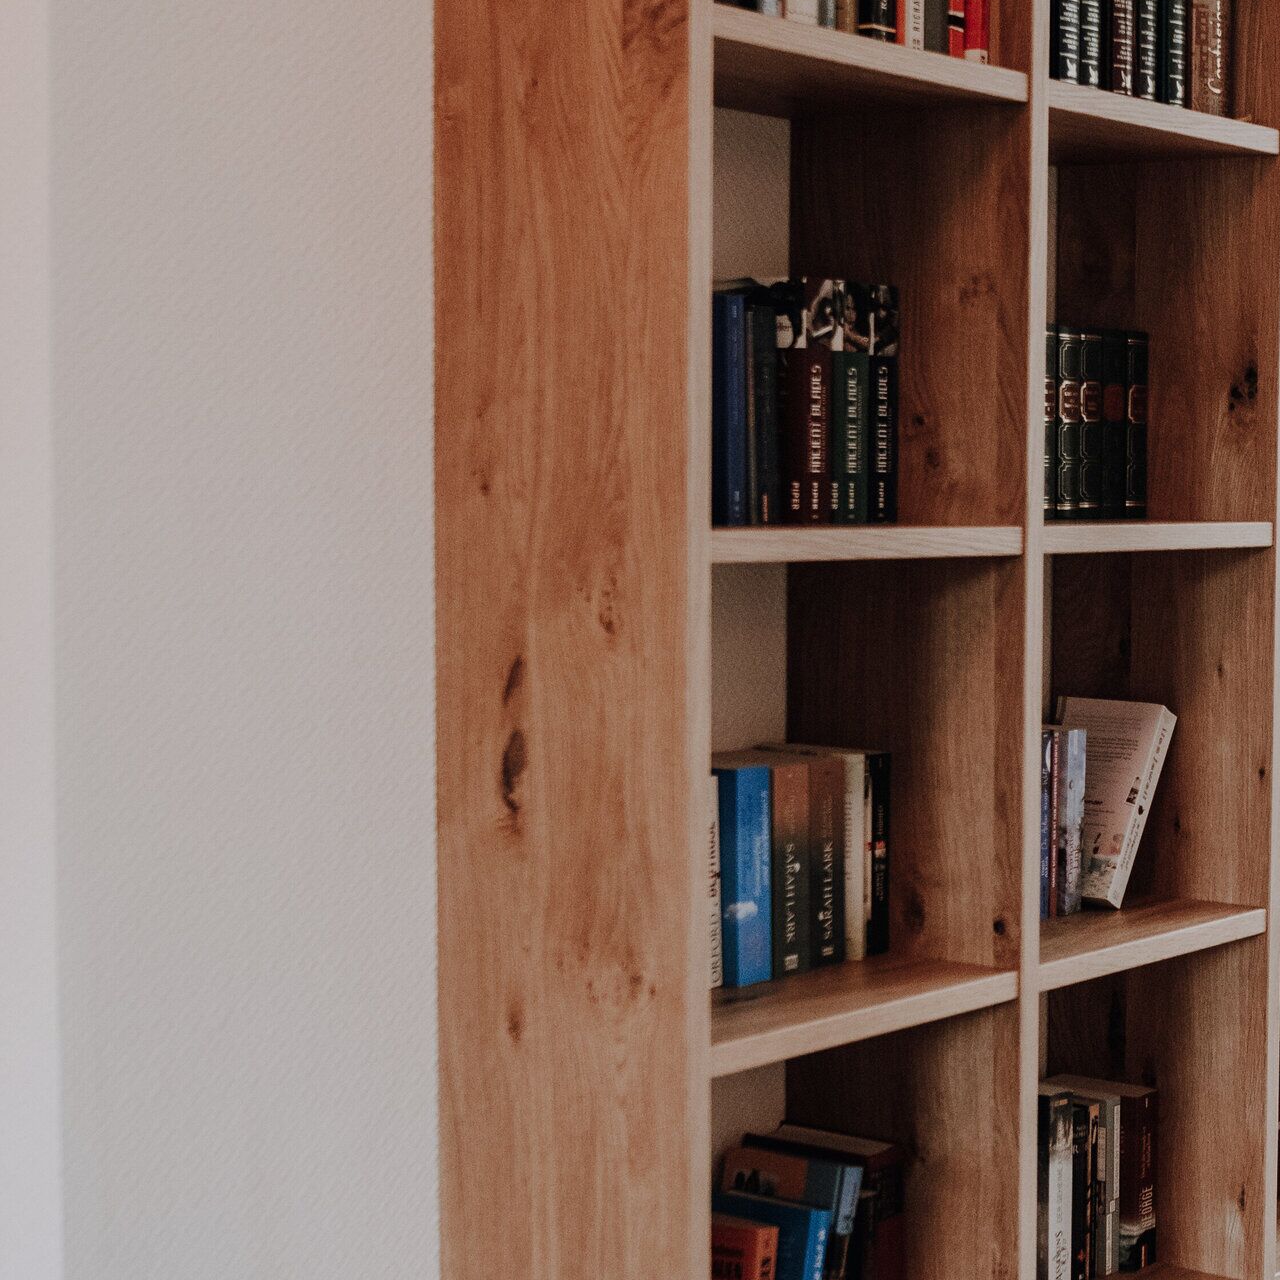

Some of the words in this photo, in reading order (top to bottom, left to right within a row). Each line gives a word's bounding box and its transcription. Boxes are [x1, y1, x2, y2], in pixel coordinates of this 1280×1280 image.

[811, 364, 822, 417] BLADES
[848, 367, 858, 418] BLADES
[877, 366, 888, 418] BLADES
[811, 422, 822, 474] ANCIENT
[847, 422, 858, 474] ANCIENT
[877, 422, 888, 474] ANCIENT
[792, 481, 800, 510] PIPER
[831, 482, 839, 510] PIPER
[785, 842, 796, 899] SARAH
[822, 839, 834, 884] LARK
[1066, 832, 1074, 886] Charlotte
[1072, 844, 1080, 870] Link
[785, 900, 796, 943] LARK
[822, 885, 834, 941] SARAH
[1140, 1184, 1154, 1228] GEORGE
